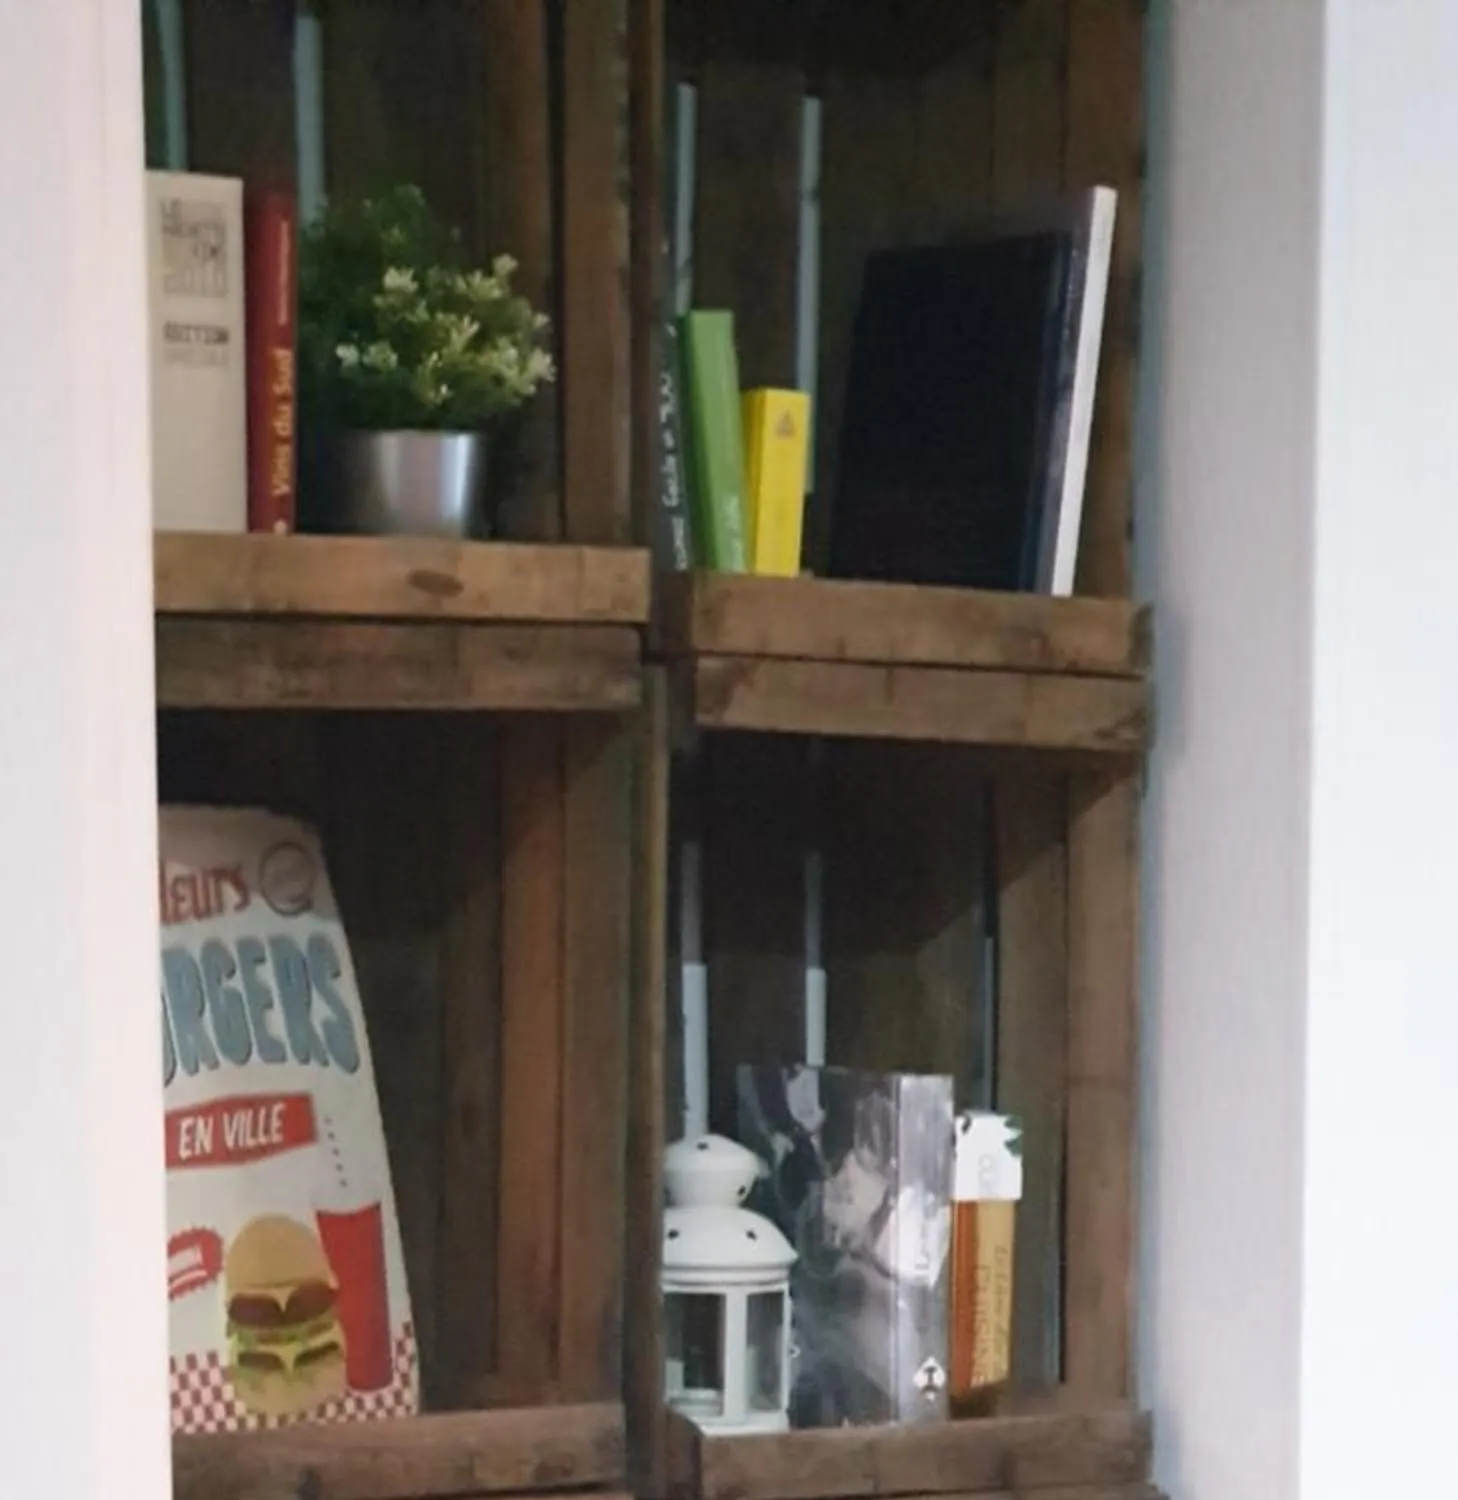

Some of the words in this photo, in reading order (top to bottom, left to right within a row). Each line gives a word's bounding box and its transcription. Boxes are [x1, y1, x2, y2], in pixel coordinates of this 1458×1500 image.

[271, 348, 293, 396] Sud
[272, 403, 292, 437] du
[271, 444, 290, 497] Vins
[161, 932, 361, 1087] RGERS
[177, 1114, 214, 1161] EN
[222, 1102, 288, 1151] VILLE
